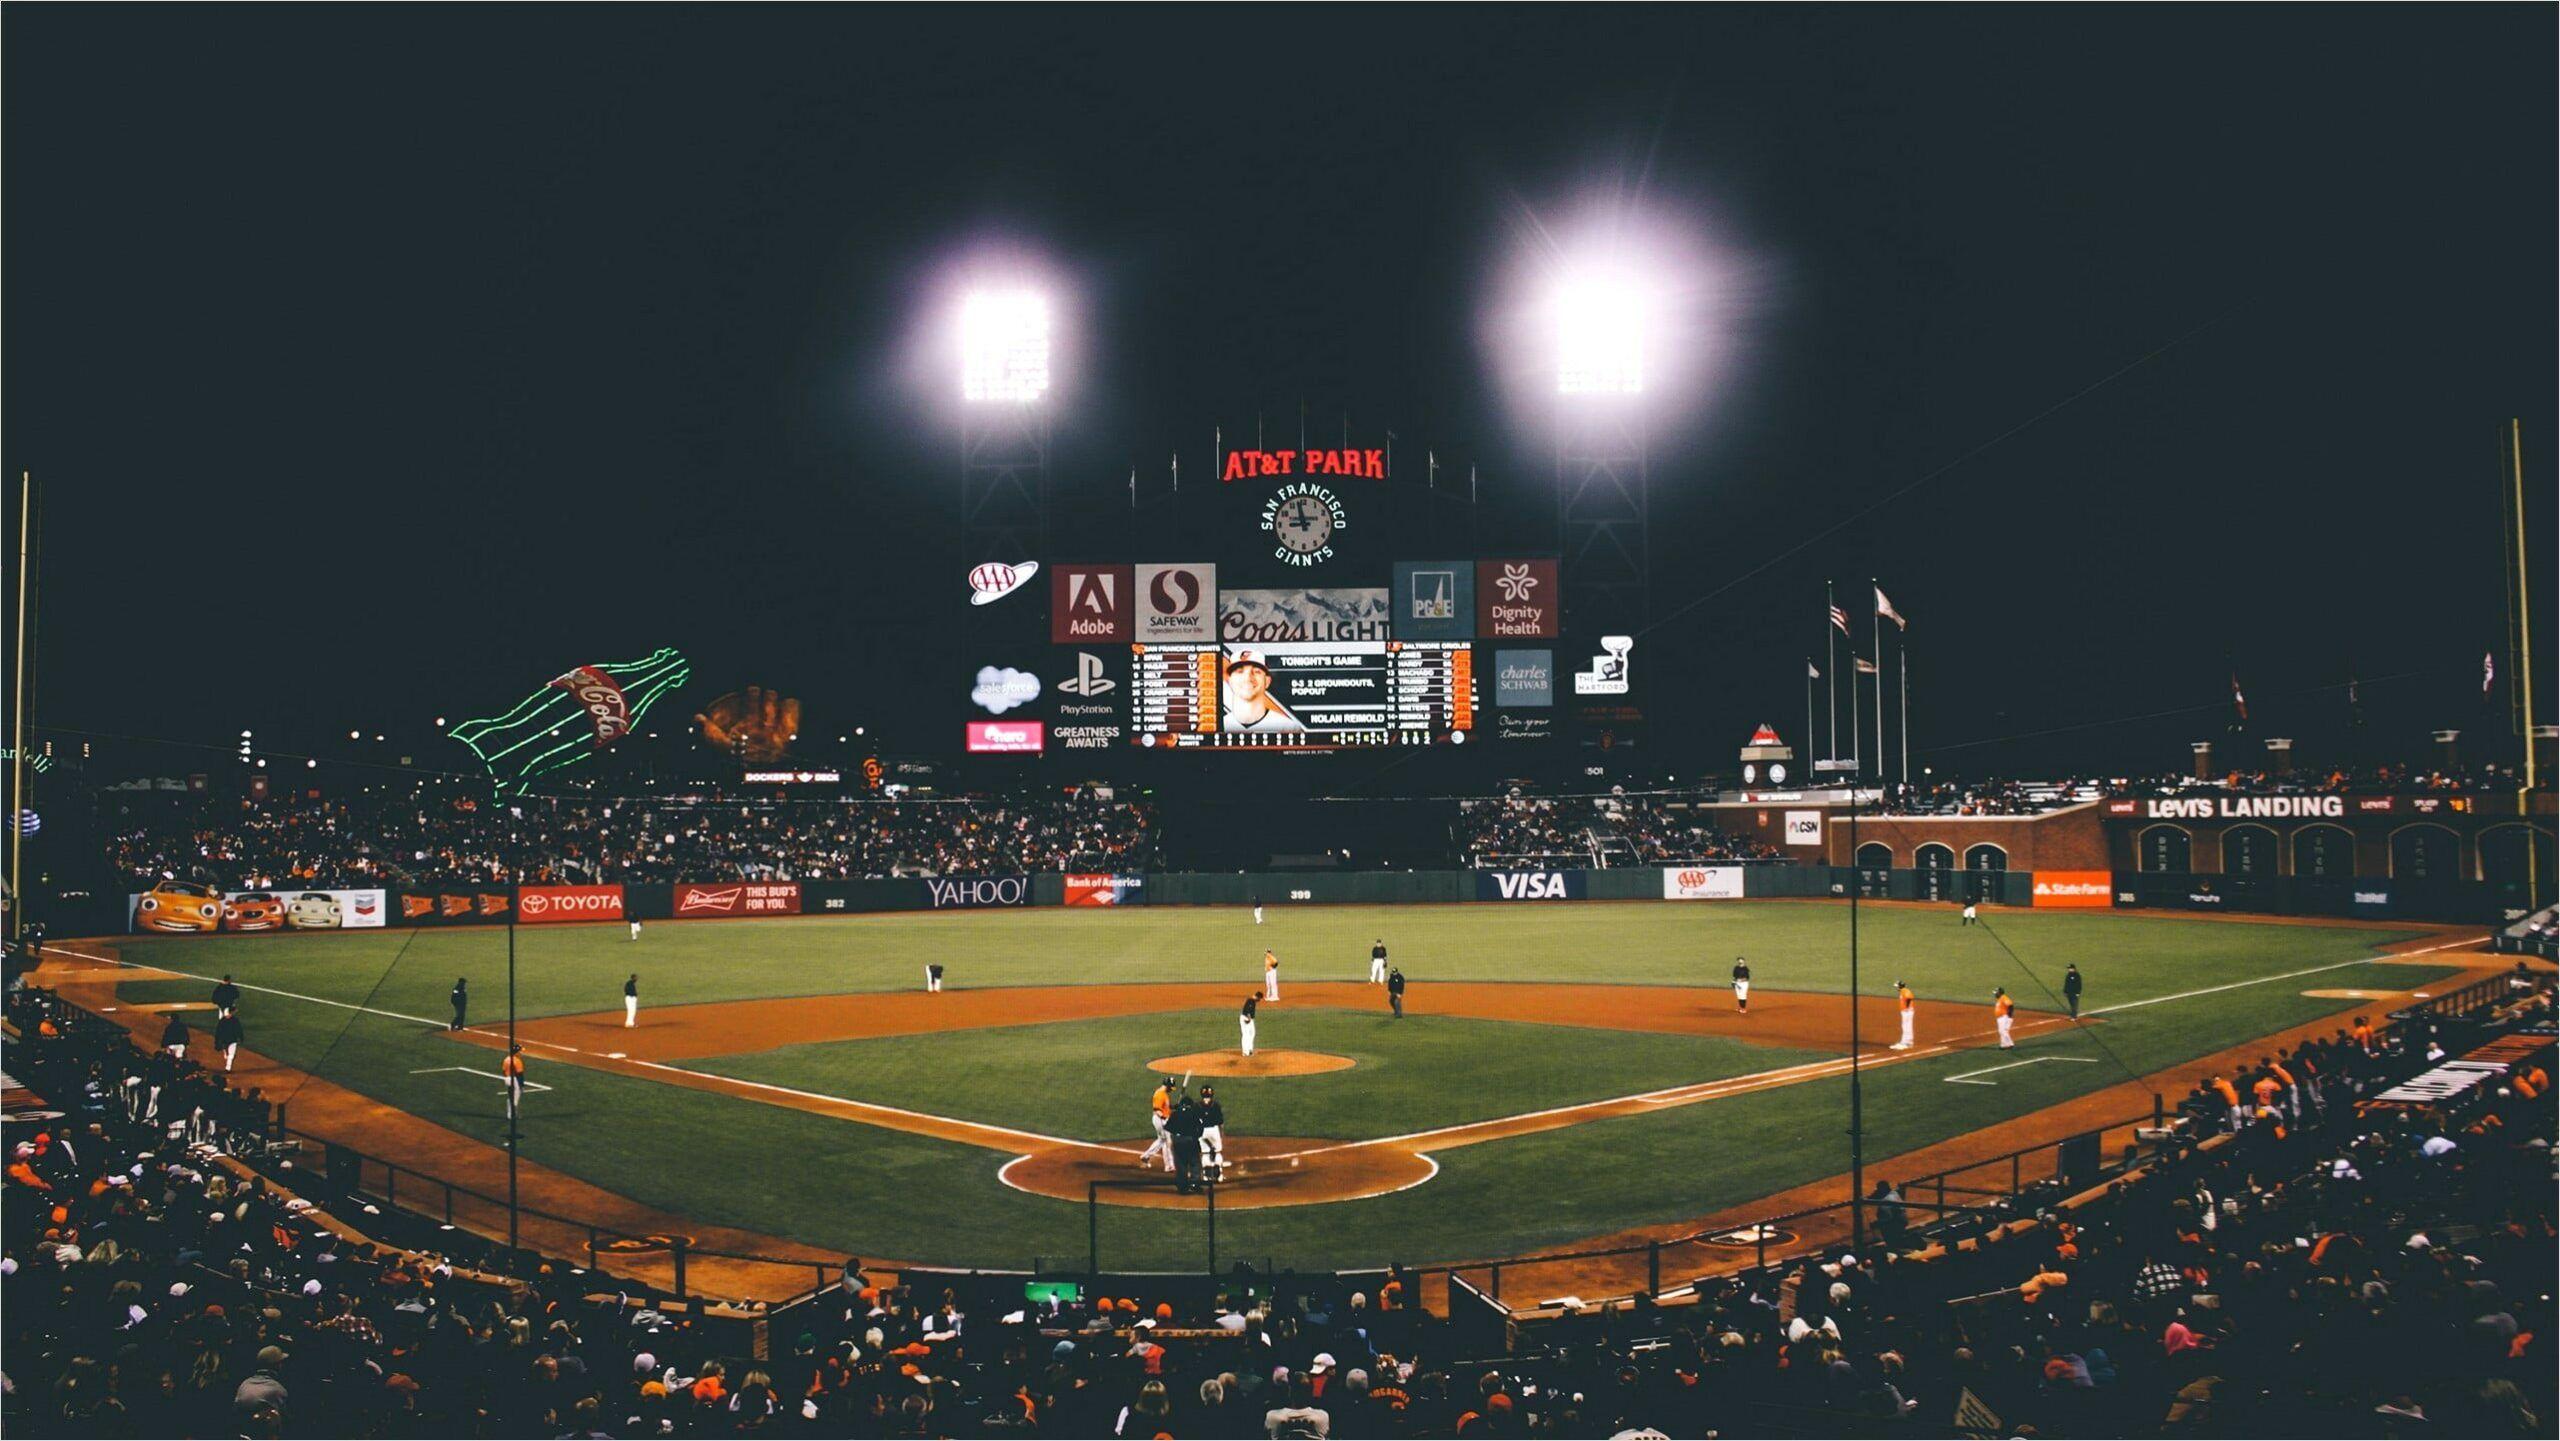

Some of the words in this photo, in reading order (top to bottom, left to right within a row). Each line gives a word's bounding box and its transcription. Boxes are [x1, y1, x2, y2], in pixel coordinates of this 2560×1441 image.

[1223, 450, 1296, 481] AT&T
[1305, 449, 1384, 480] PARK
[1261, 498, 1279, 530] SAN
[1277, 482, 1346, 529] FRANCISCO
[1275, 545, 1333, 567] GIANTS
[1492, 605, 1543, 622] Dignity
[1070, 619, 1114, 636] Adobe
[1150, 616, 1200, 627] SAFEWAY
[1221, 611, 1309, 642] Coors
[1312, 620, 1390, 642] LIGHT
[1494, 622, 1541, 635] Health
[1402, 642, 1440, 650] BALTIMORE
[1441, 642, 1471, 650] ORIOLES
[1280, 656, 1332, 666] TONIGHT'S
[1333, 656, 1362, 666] GAME
[1398, 651, 1422, 659] JONES
[1501, 664, 1547, 680] charles
[1291, 679, 1305, 688] 0-3
[1307, 679, 1314, 688] 2
[1314, 678, 1375, 688] GROUNDOUTS,
[1500, 680, 1548, 690] SCHWAB
[1578, 675, 1594, 683] THE
[1291, 687, 1327, 696] POPOUT
[1577, 683, 1626, 691] HARTFORD
[1060, 705, 1112, 717] PlayStation
[1310, 714, 1343, 724] NOLAN
[1344, 713, 1385, 723] REIMOLD
[1500, 714, 1522, 726] Own
[1523, 718, 1550, 730] your
[1054, 726, 1120, 738] GREATNESS
[1065, 737, 1109, 748] AWAITS
[1424, 736, 1431, 745] 2
[745, 773, 794, 782] DOCKERS
[814, 773, 840, 782] DECK
[2221, 796, 2343, 818] LANDING
[1800, 821, 1818, 833] CSN
[1066, 877, 1091, 888] Bank
[1091, 877, 1101, 888] of
[1102, 877, 1142, 888] America
[1491, 872, 1567, 899] VISA
[1678, 871, 1706, 888] AAA
[746, 886, 767, 897] THIS
[768, 885, 797, 897] BUD'S
[927, 877, 1028, 907] YAHOO!
[1290, 890, 1311, 900] 399
[552, 895, 622, 910] TOYOTA
[746, 899, 764, 910] FOR
[766, 899, 787, 909] YOU.
[825, 899, 845, 908] 382
